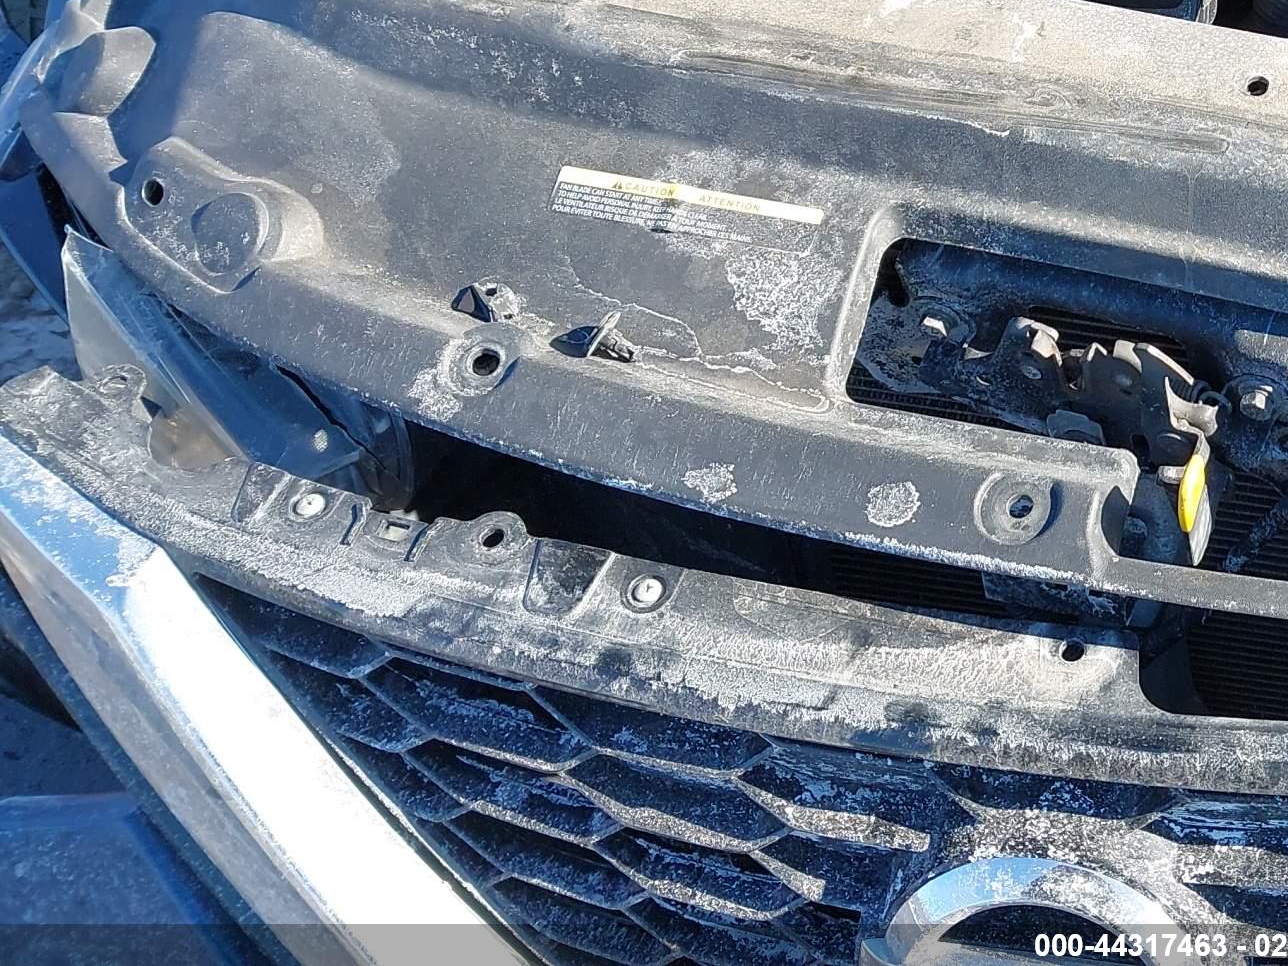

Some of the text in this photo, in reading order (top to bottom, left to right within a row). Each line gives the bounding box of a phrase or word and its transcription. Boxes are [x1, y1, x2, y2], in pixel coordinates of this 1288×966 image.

[572, 185, 591, 193] BLADE
[604, 190, 621, 198] START
[630, 194, 643, 202] ANY
[625, 182, 674, 196] CAUTION
[566, 191, 582, 199] HELP
[581, 194, 601, 202] AVOID
[600, 197, 631, 207] PERSONAL
[699, 195, 760, 211] ATTENTION
[551, 204, 570, 212] POUR
[592, 210, 613, 219] TOUTE
[563, 198, 604, 210] VENTILATEUR
[604, 205, 628, 214] RISQUE
[677, 217, 695, 225] TOUT
